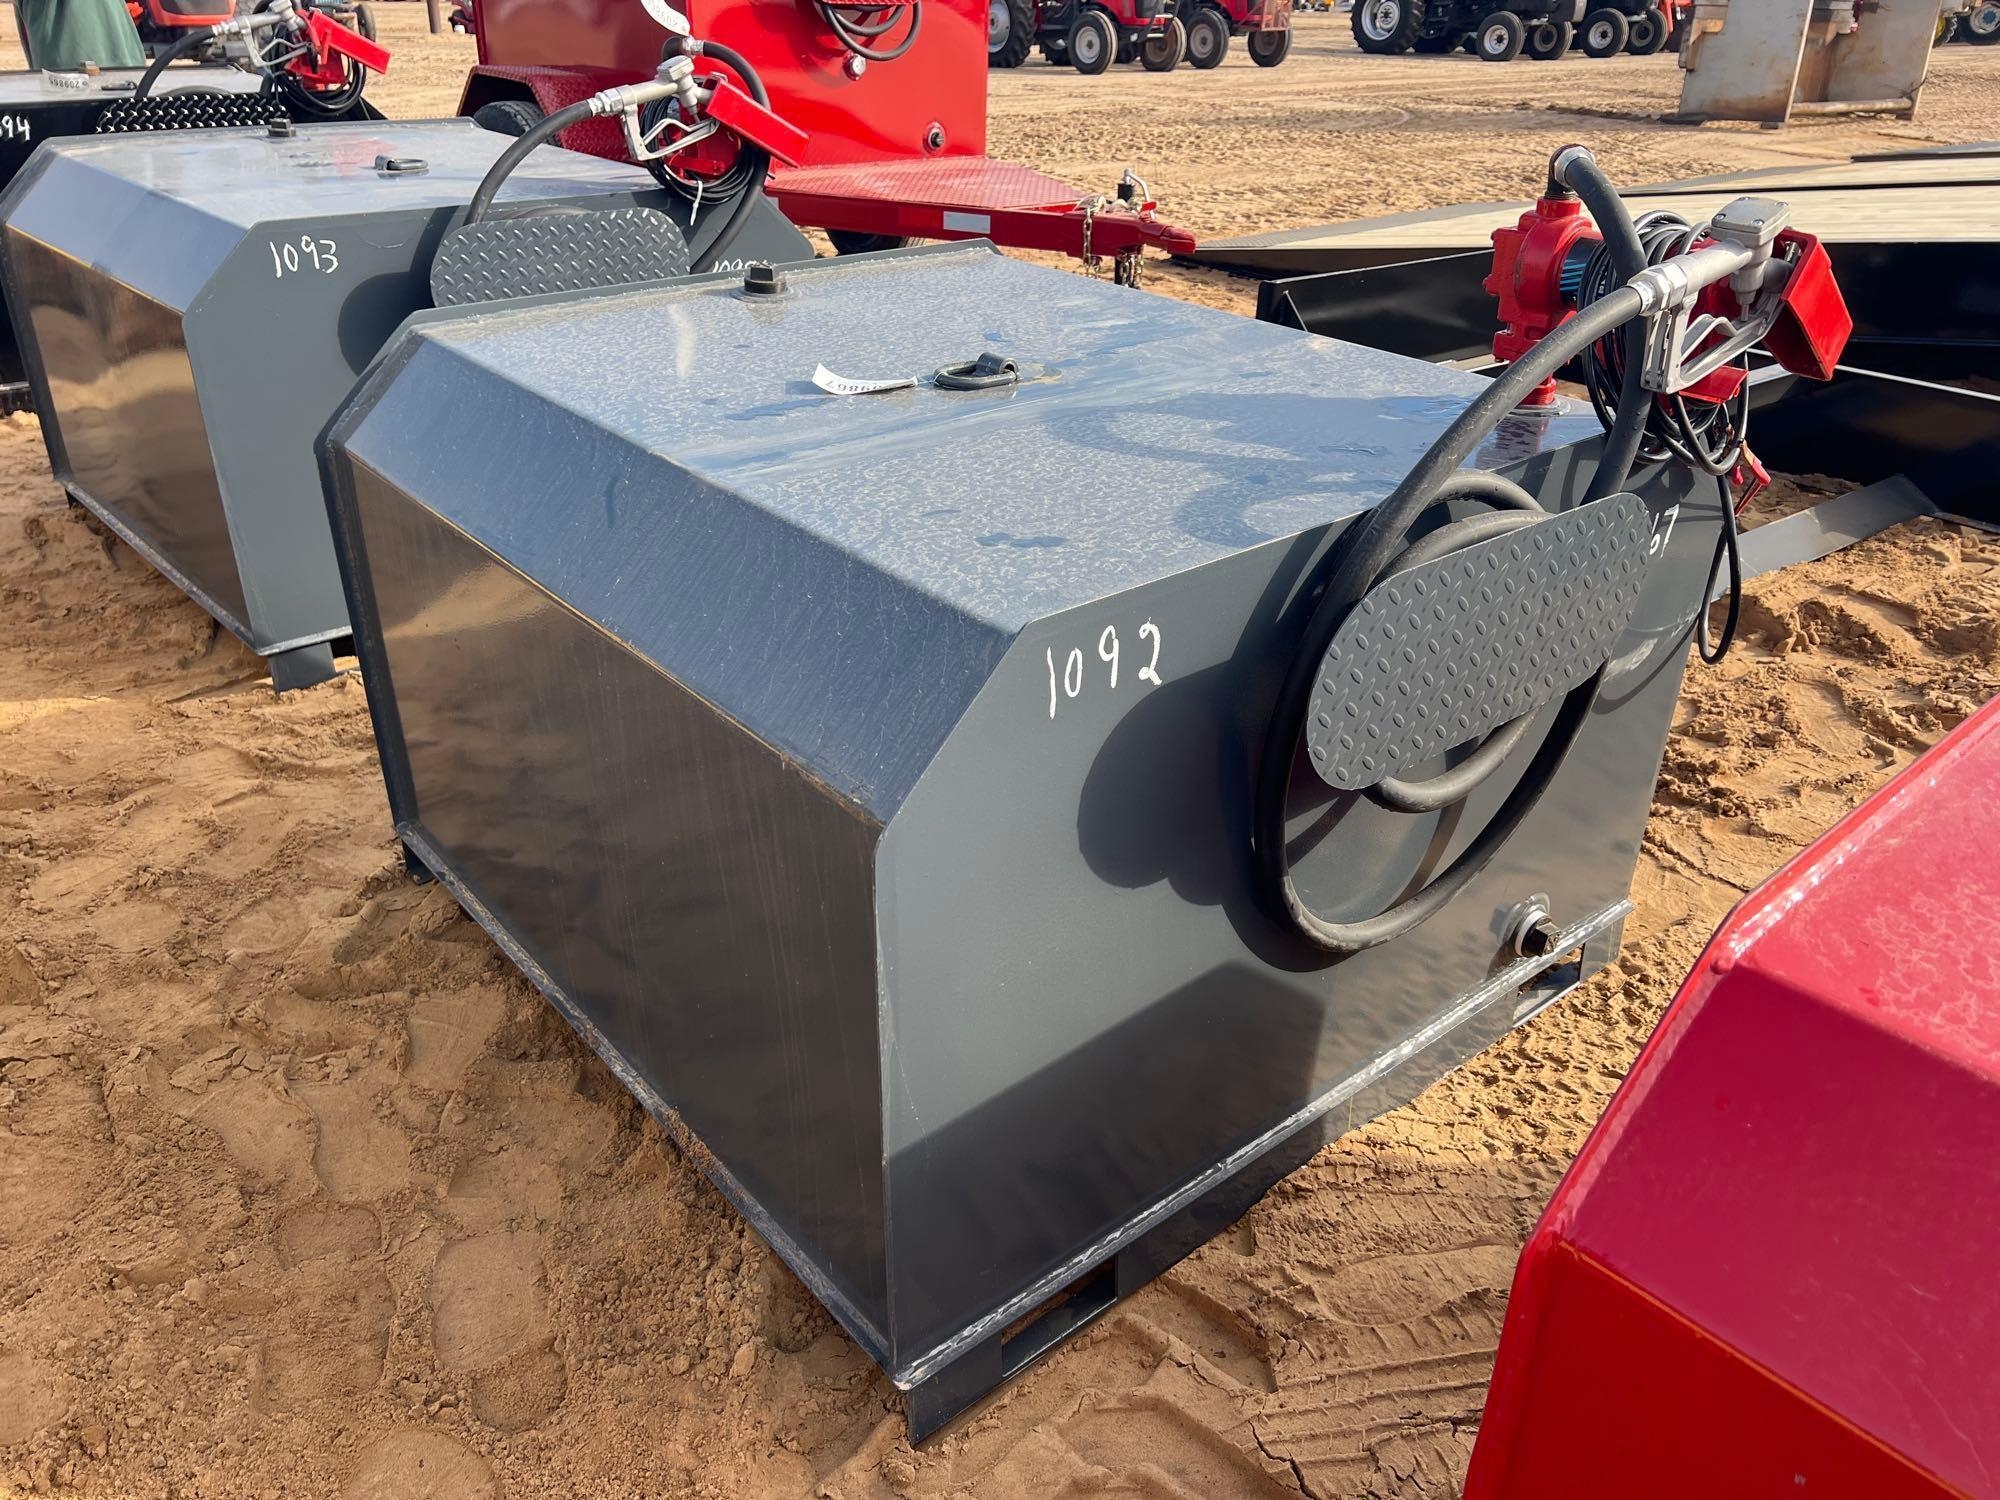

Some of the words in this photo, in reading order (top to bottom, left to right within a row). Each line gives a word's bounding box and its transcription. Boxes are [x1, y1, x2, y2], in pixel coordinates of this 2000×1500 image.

[0, 115, 31, 141] 94
[269, 235, 339, 278] 1093
[1047, 617, 1162, 719] 1092
